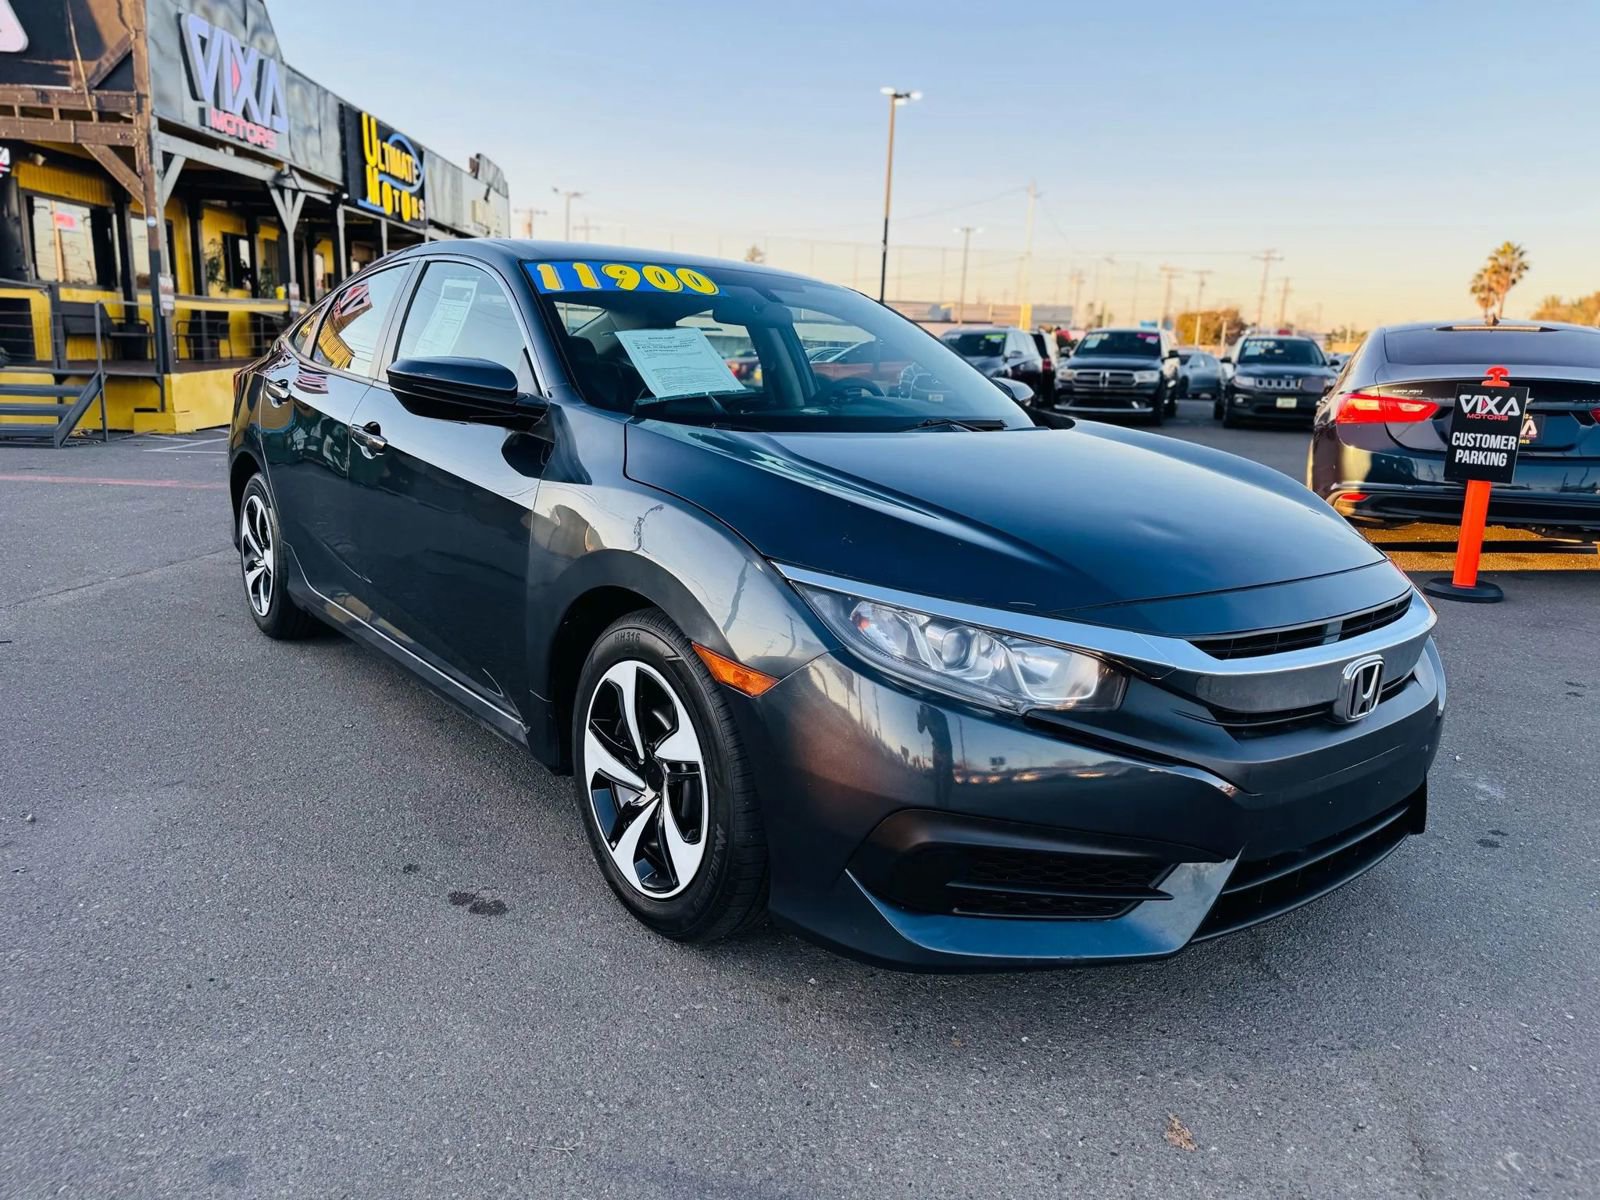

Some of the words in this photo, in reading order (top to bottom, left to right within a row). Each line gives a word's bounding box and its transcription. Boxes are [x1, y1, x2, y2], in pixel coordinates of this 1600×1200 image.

[183, 12, 289, 134] VIXA
[209, 106, 278, 151] MOTORS
[361, 111, 420, 185] ULTIMATE
[365, 164, 425, 222] MOTORS
[536, 262, 720, 296] 11900
[1459, 394, 1521, 416] VIXA
[1466, 413, 1509, 421] MOTORS
[1451, 431, 1517, 451] CUSTOMER
[1455, 449, 1508, 467] PARKING
